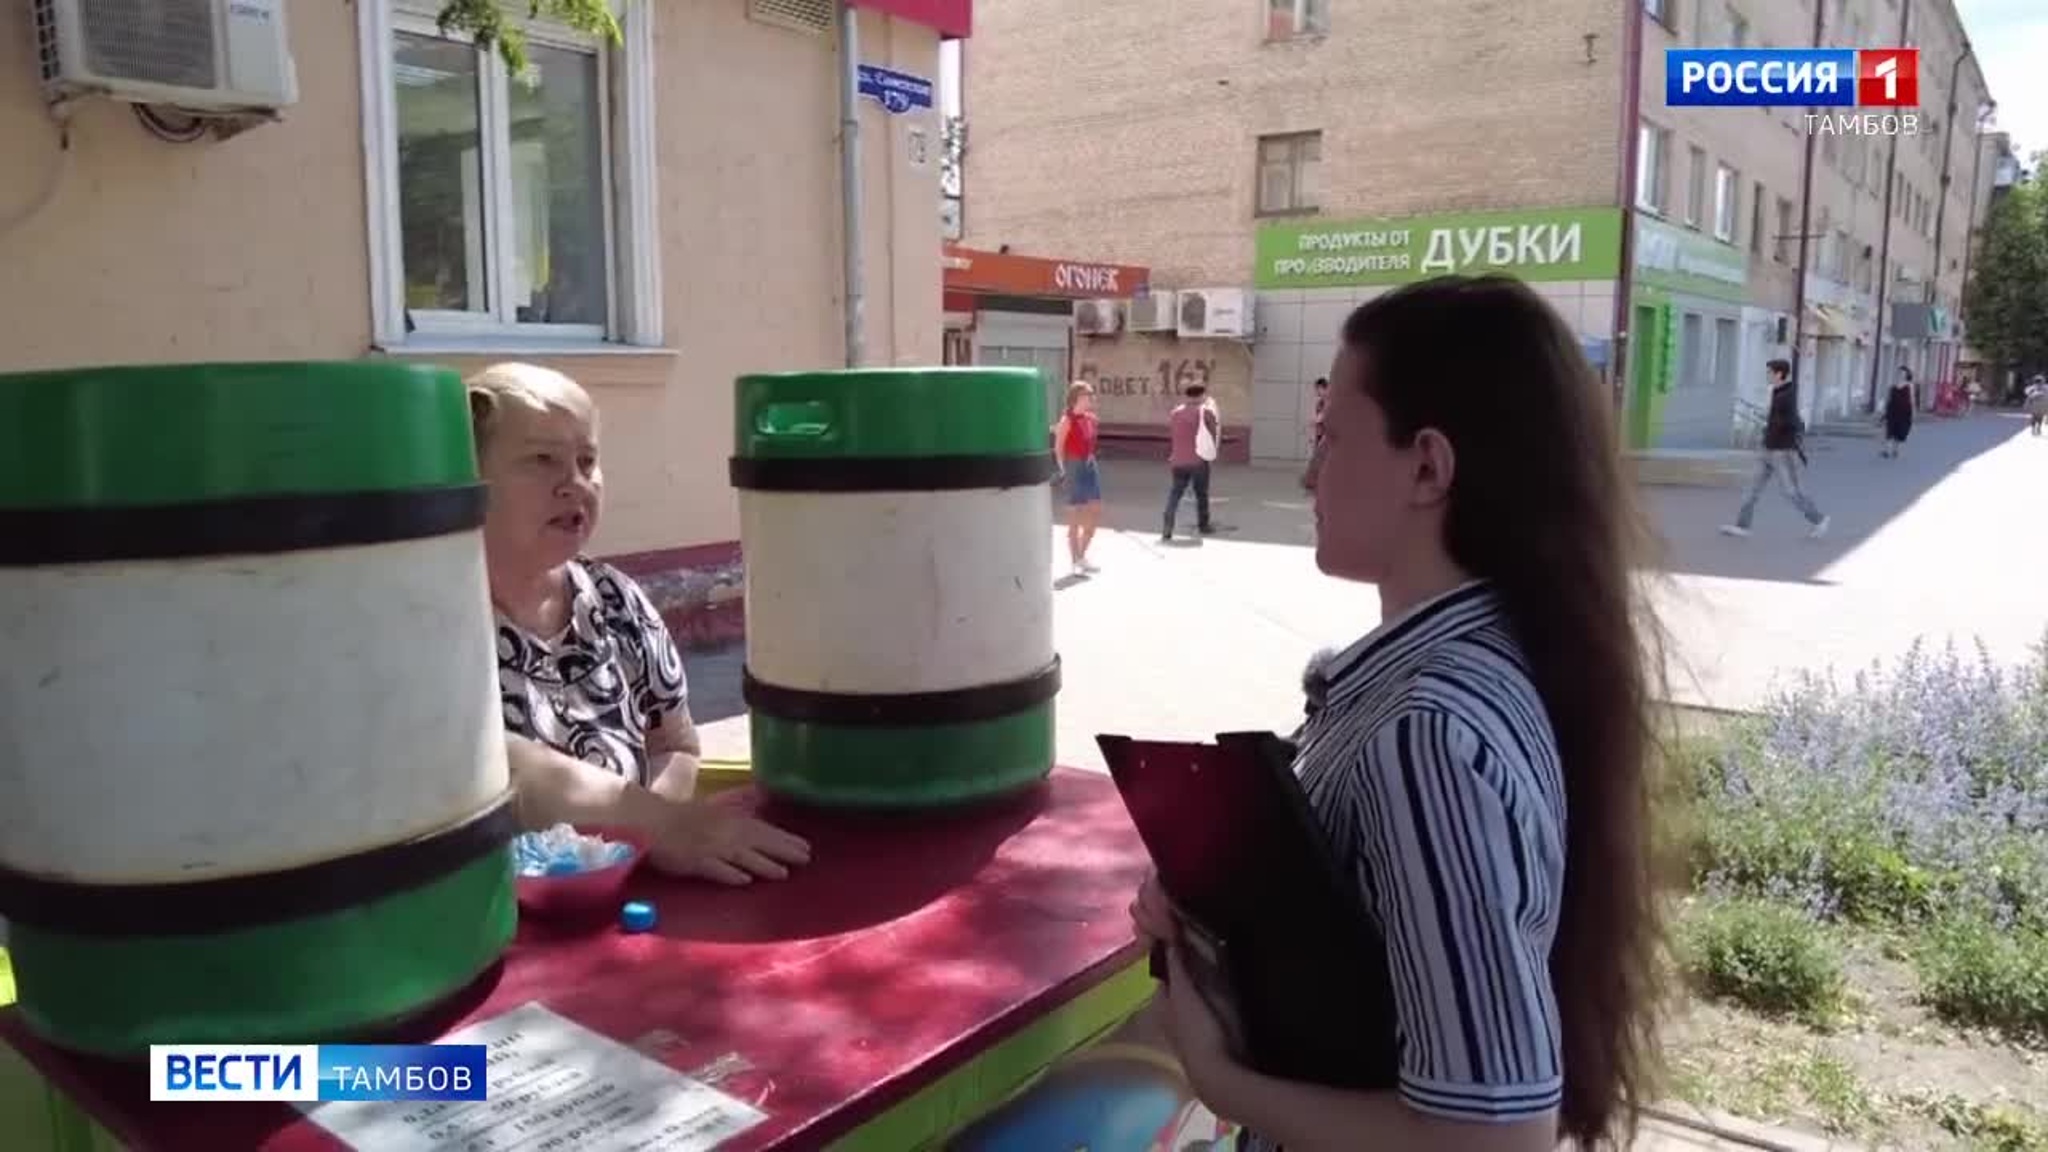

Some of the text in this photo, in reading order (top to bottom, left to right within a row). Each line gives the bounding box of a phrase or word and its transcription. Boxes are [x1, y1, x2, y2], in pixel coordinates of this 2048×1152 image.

[1299, 229, 1409, 251] ПРОДУКТЫ ОТ
[1421, 221, 1581, 274] ДУБКИ
